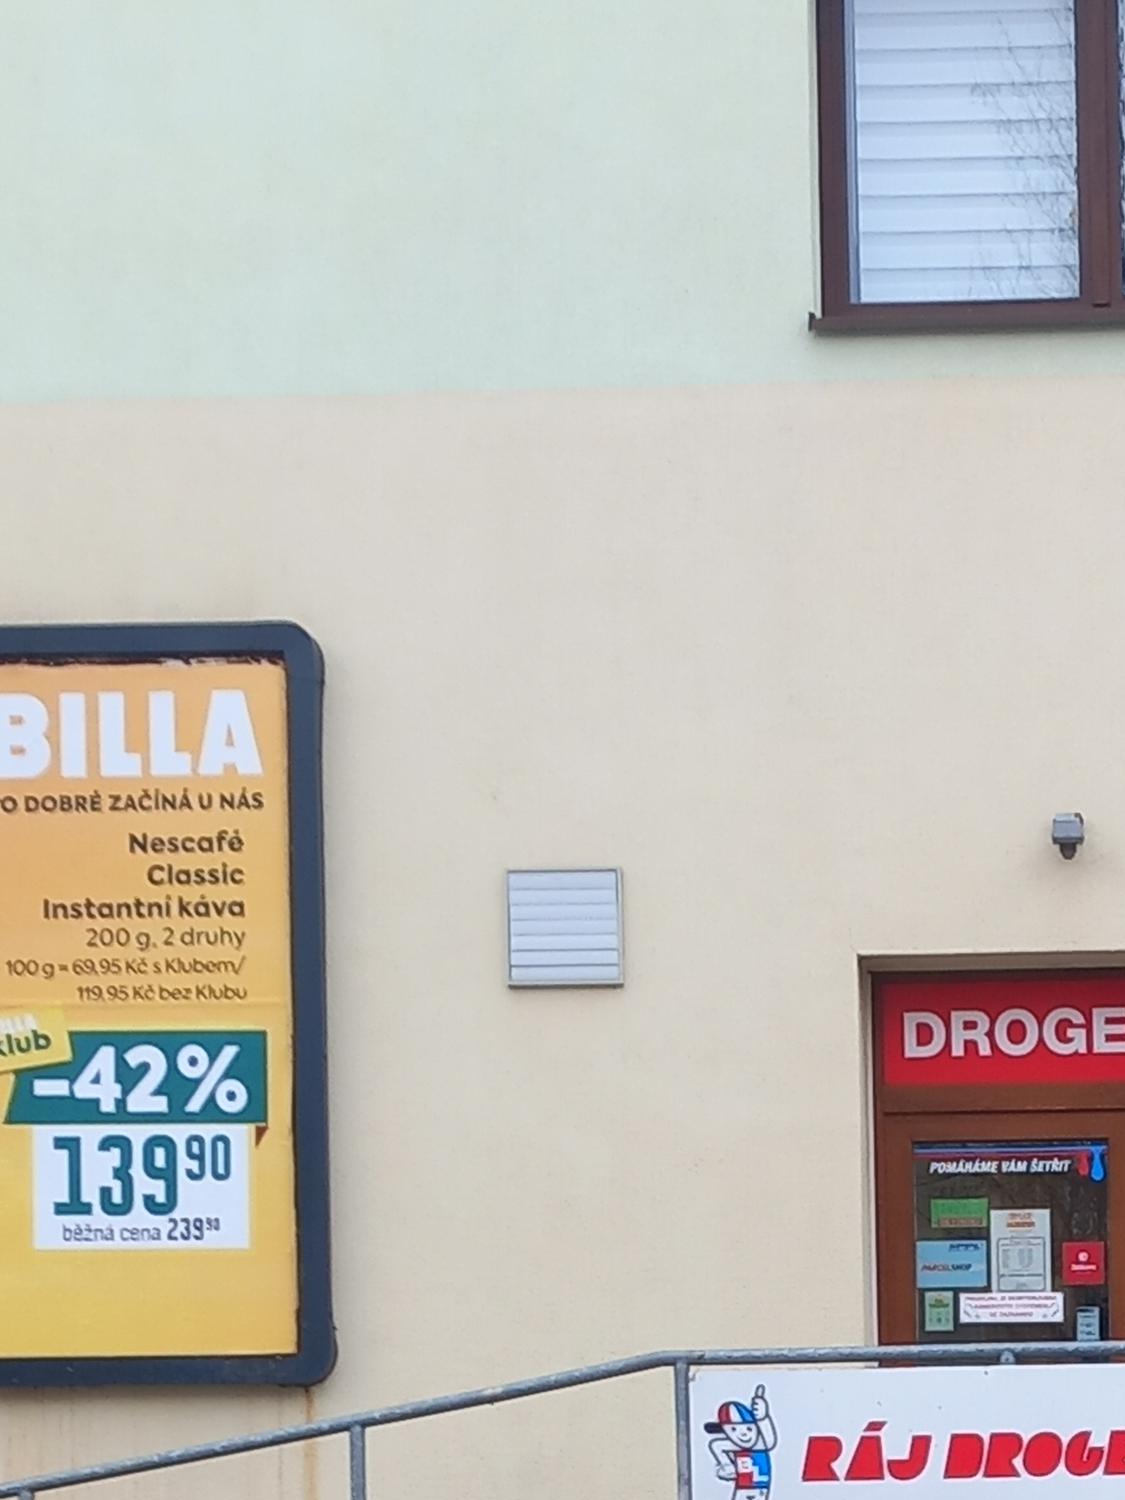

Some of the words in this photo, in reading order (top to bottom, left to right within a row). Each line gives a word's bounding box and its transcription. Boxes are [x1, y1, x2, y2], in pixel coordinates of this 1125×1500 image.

[0, 689, 264, 779] BILLA
[24, 789, 102, 813] DOBRÉ
[108, 787, 192, 812] ZAČÍNÁ
[199, 793, 212, 811] U
[219, 786, 264, 811] NÁS
[128, 829, 245, 854] Nescafé
[147, 862, 245, 886] Classic
[43, 894, 171, 920] Instantní
[178, 894, 245, 918] káva
[86, 927, 130, 947] 200
[162, 926, 174, 946] 2
[180, 926, 246, 949] druhy
[6, 959, 39, 977] 100
[126, 957, 148, 975] Kč
[153, 959, 161, 974] s
[133, 985, 155, 1001] Kč
[159, 984, 192, 1000] bez
[195, 983, 247, 1000] Klubu
[32, 1044, 249, 1114] -42%
[1002, 1158, 1028, 1173] VÁM
[62, 1224, 115, 1242] běžná
[120, 1229, 162, 1242] cena
[801, 1420, 932, 1482] RÁJ
